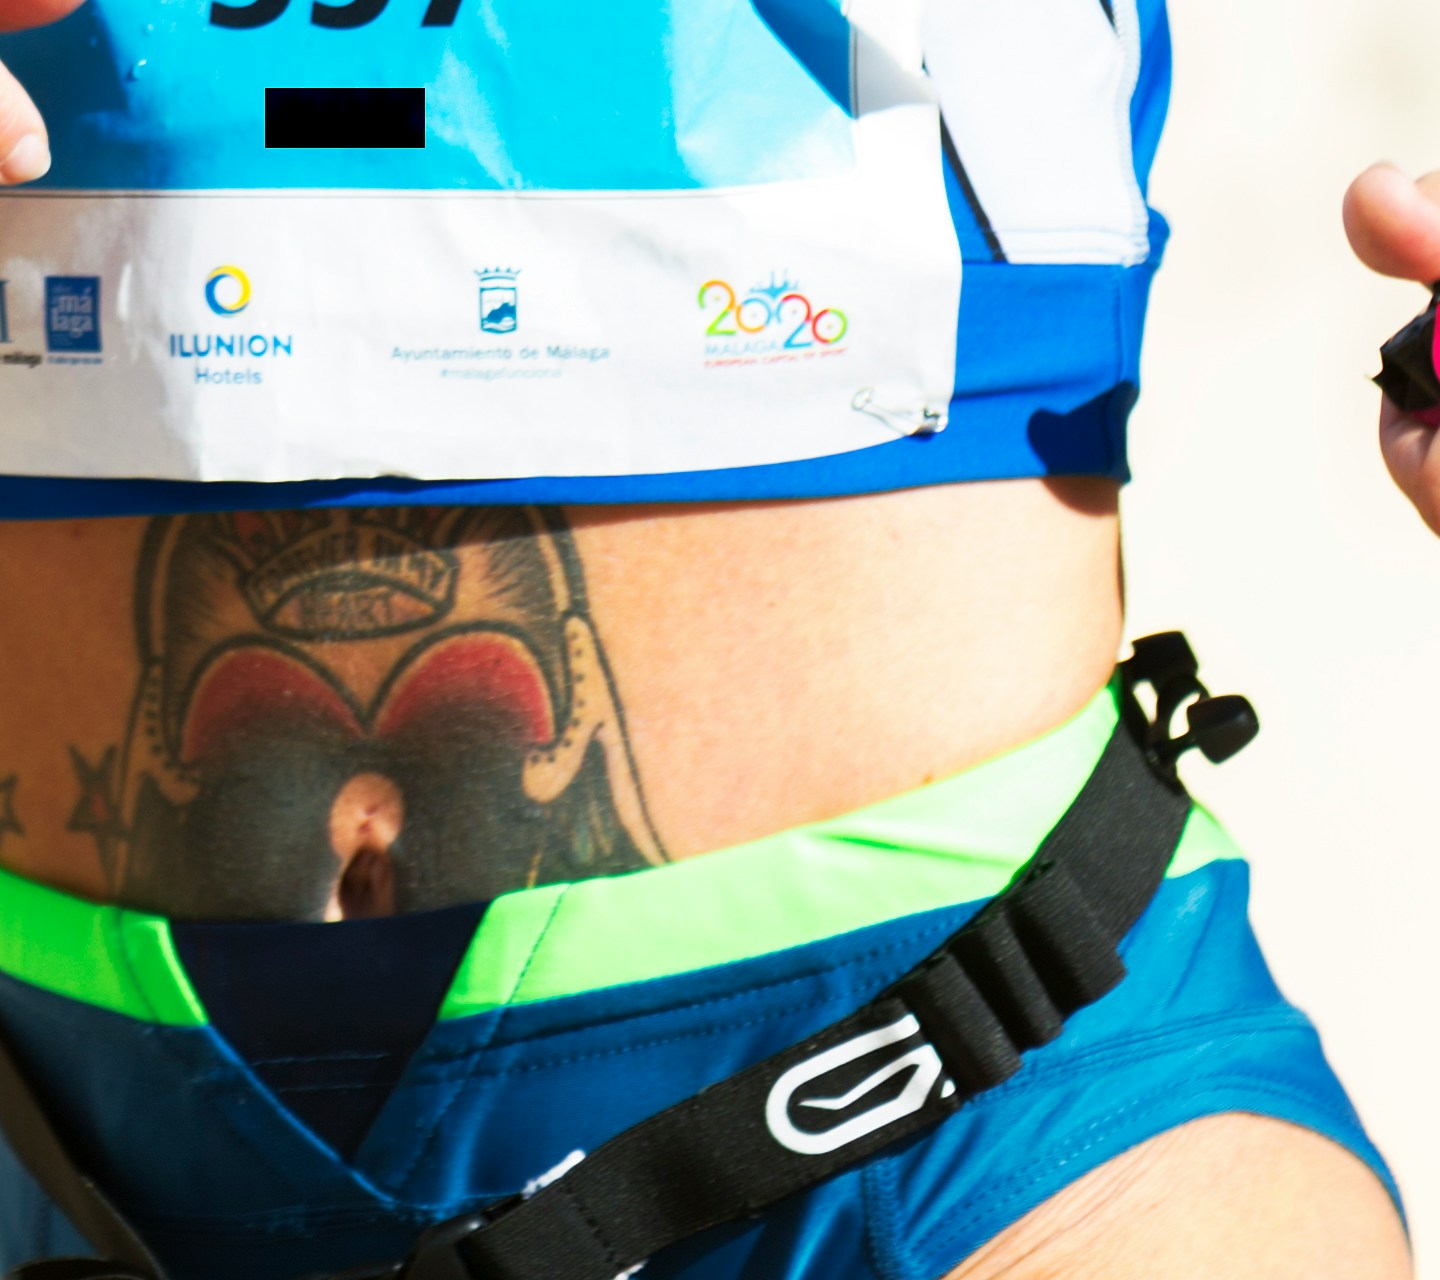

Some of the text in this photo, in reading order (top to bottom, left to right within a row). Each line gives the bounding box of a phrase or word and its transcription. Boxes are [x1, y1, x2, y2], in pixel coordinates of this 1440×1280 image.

[696, 278, 850, 351] 2020
[168, 334, 293, 360] ILUNION
[390, 345, 513, 364] Ayuntamiento
[518, 344, 540, 360] de
[194, 366, 263, 385] Hotels
